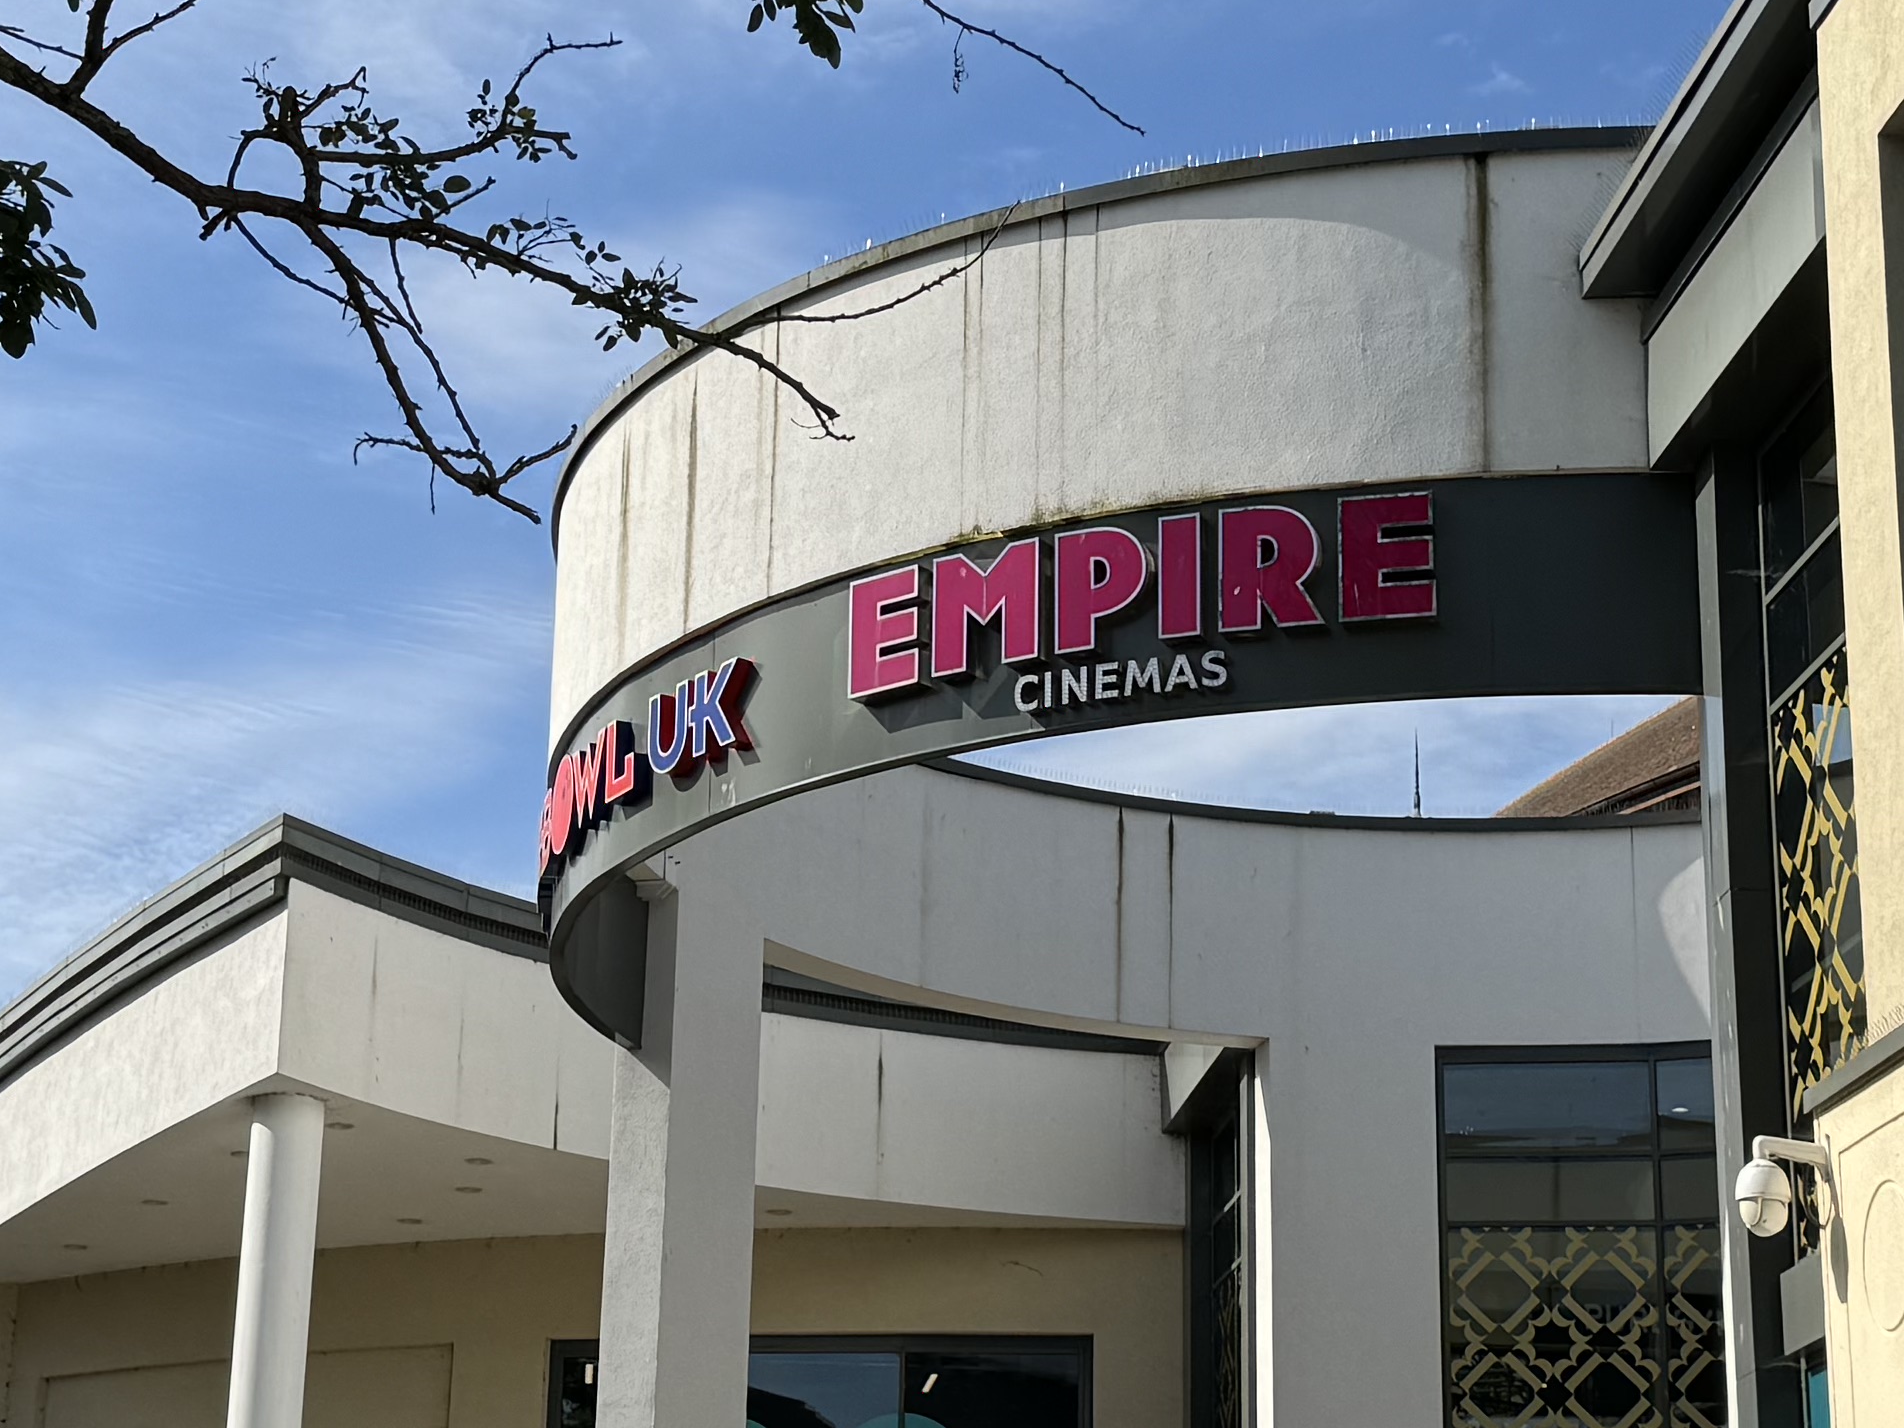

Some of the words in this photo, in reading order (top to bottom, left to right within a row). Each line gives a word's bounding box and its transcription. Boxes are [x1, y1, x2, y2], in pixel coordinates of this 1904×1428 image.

[847, 490, 1437, 701] EMPIRE
[648, 656, 738, 774] UK
[1013, 649, 1228, 713] CINEMAS
